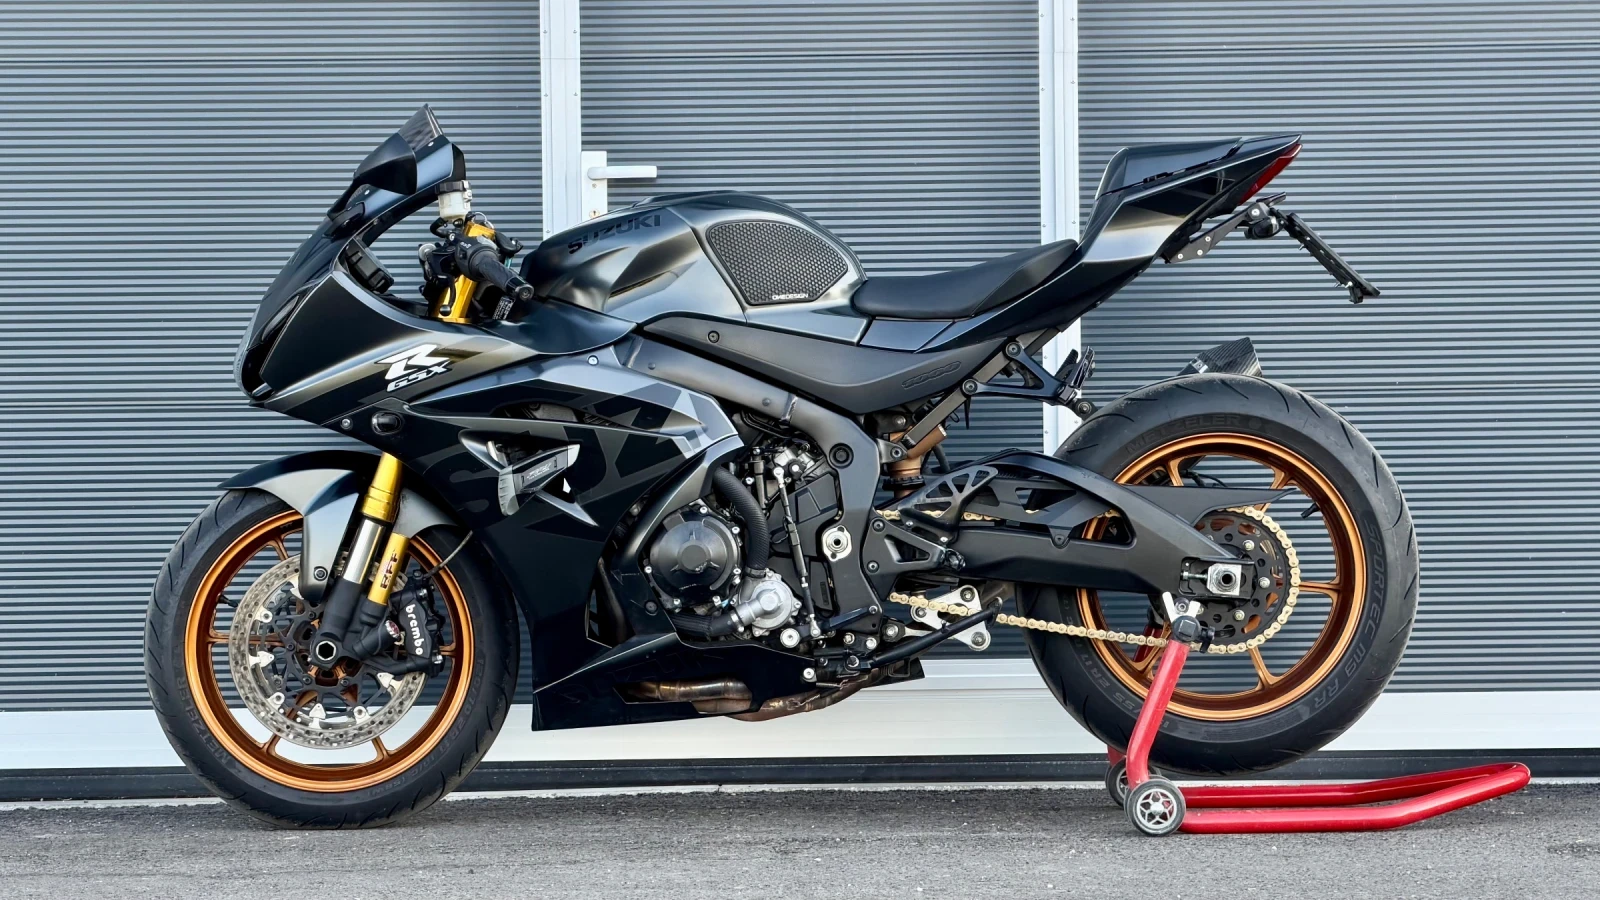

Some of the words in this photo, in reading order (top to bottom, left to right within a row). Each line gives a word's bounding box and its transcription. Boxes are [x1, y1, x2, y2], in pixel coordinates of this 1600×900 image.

[567, 214, 661, 254] SUZUKI
[375, 344, 450, 380] R
[386, 361, 450, 393] GSX
[1125, 413, 1240, 455] METZELER
[1362, 517, 1384, 638] SPORTEC
[405, 603, 425, 656] brembo
[1310, 676, 1343, 707] RR
[176, 676, 230, 765] METZELER
